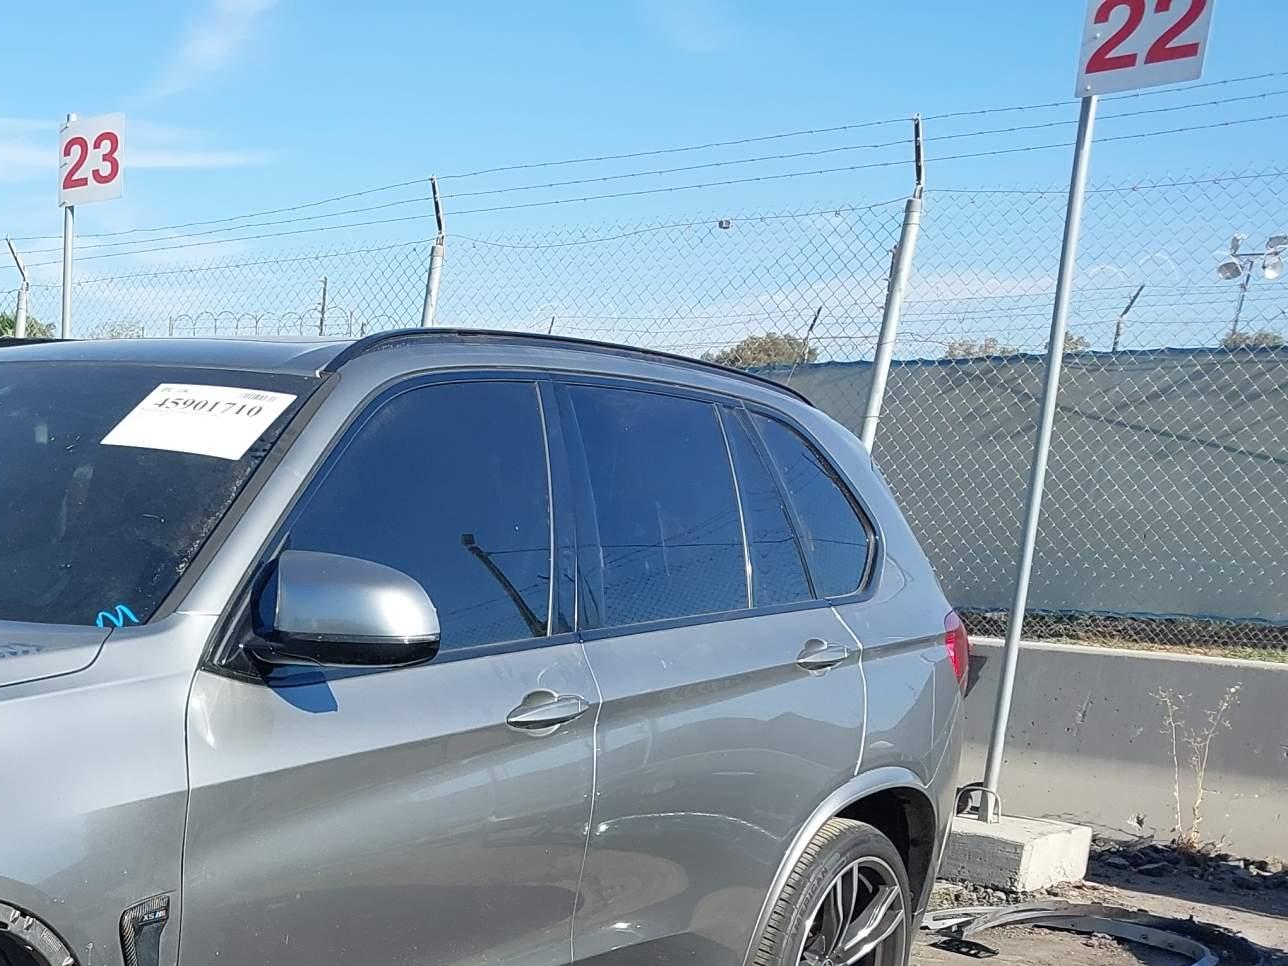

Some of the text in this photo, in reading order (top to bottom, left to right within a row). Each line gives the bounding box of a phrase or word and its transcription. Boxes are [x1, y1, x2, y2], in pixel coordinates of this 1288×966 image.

[1085, 0, 1207, 74] 22
[62, 131, 120, 190] 23
[154, 397, 263, 417] 45901710
